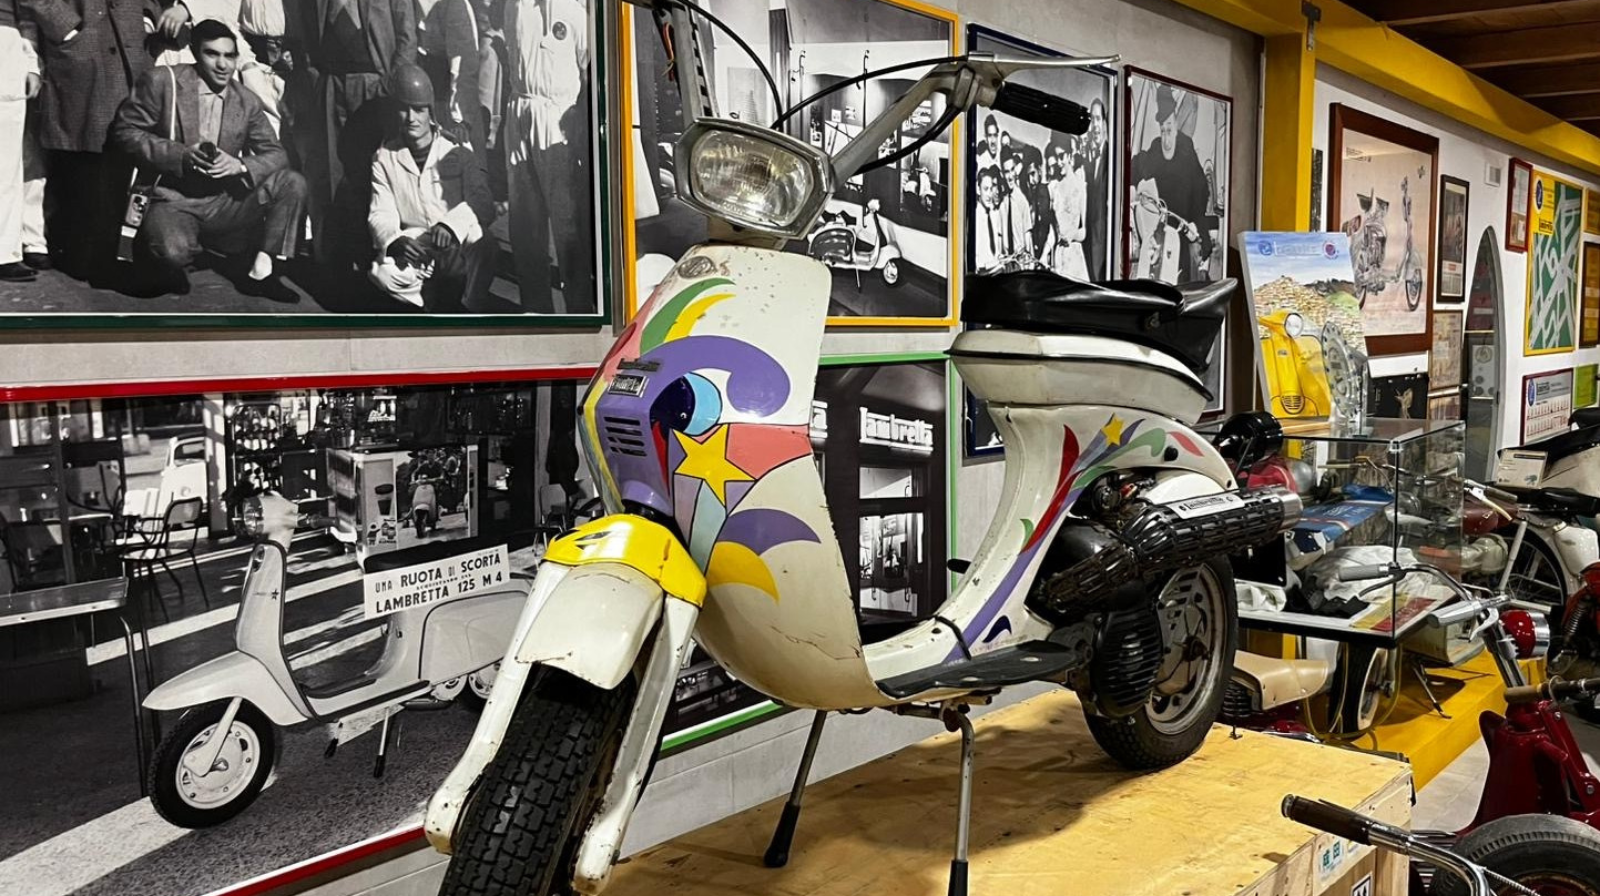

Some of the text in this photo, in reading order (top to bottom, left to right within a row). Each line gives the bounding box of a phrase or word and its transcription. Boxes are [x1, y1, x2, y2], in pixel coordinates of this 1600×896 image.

[375, 580, 392, 593] UNA
[400, 568, 442, 587] RUOTA
[461, 553, 501, 573] SCORTA
[376, 571, 502, 613] LAMBRETTA 125 M 4
